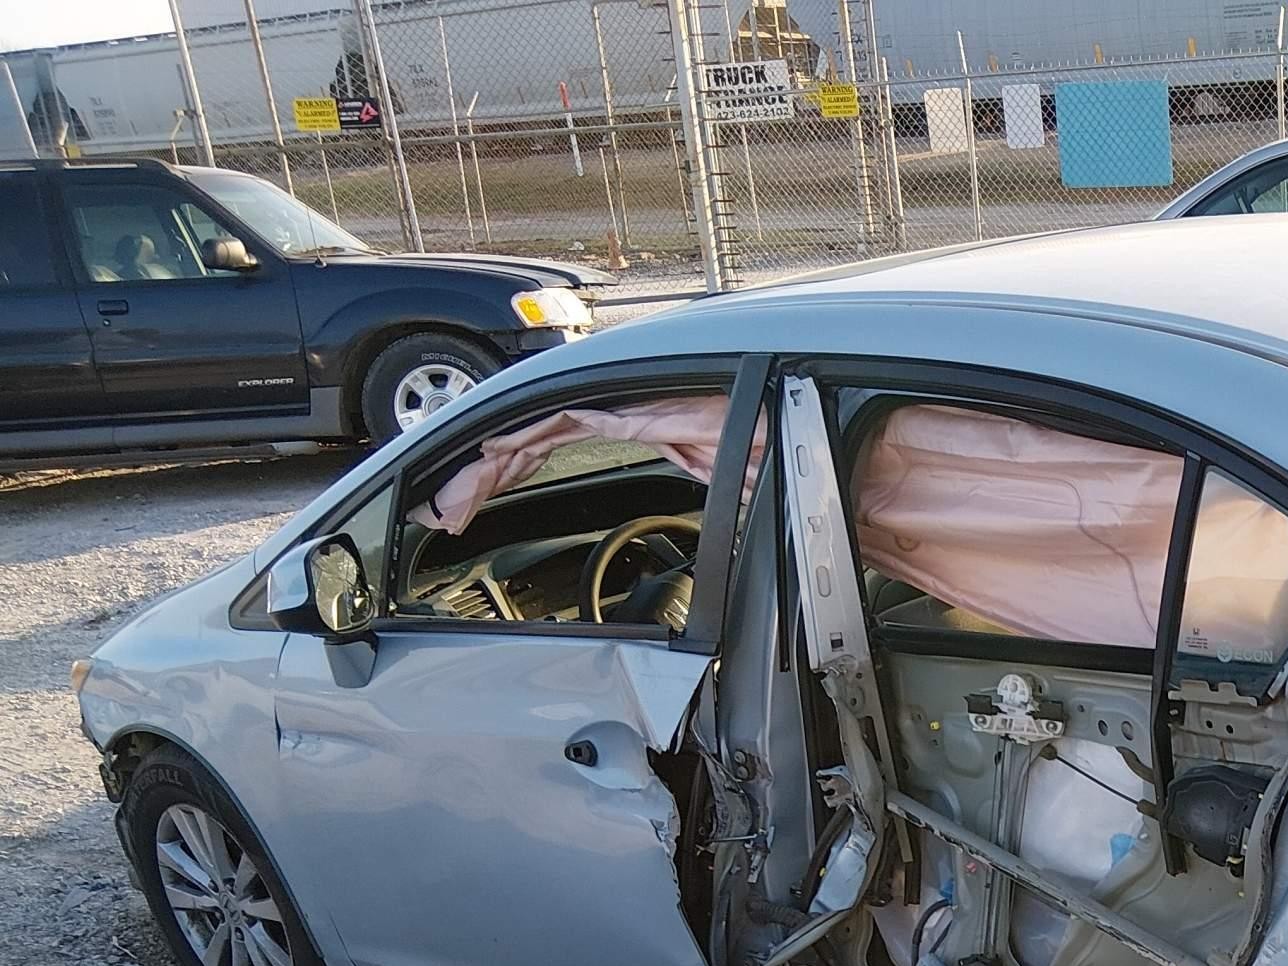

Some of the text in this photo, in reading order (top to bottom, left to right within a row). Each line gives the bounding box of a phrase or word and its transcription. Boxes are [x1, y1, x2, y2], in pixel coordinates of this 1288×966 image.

[705, 64, 768, 87] TRUCK
[821, 86, 853, 94] WARNING
[296, 100, 334, 109] WARNING
[238, 377, 295, 387] EXPLORER
